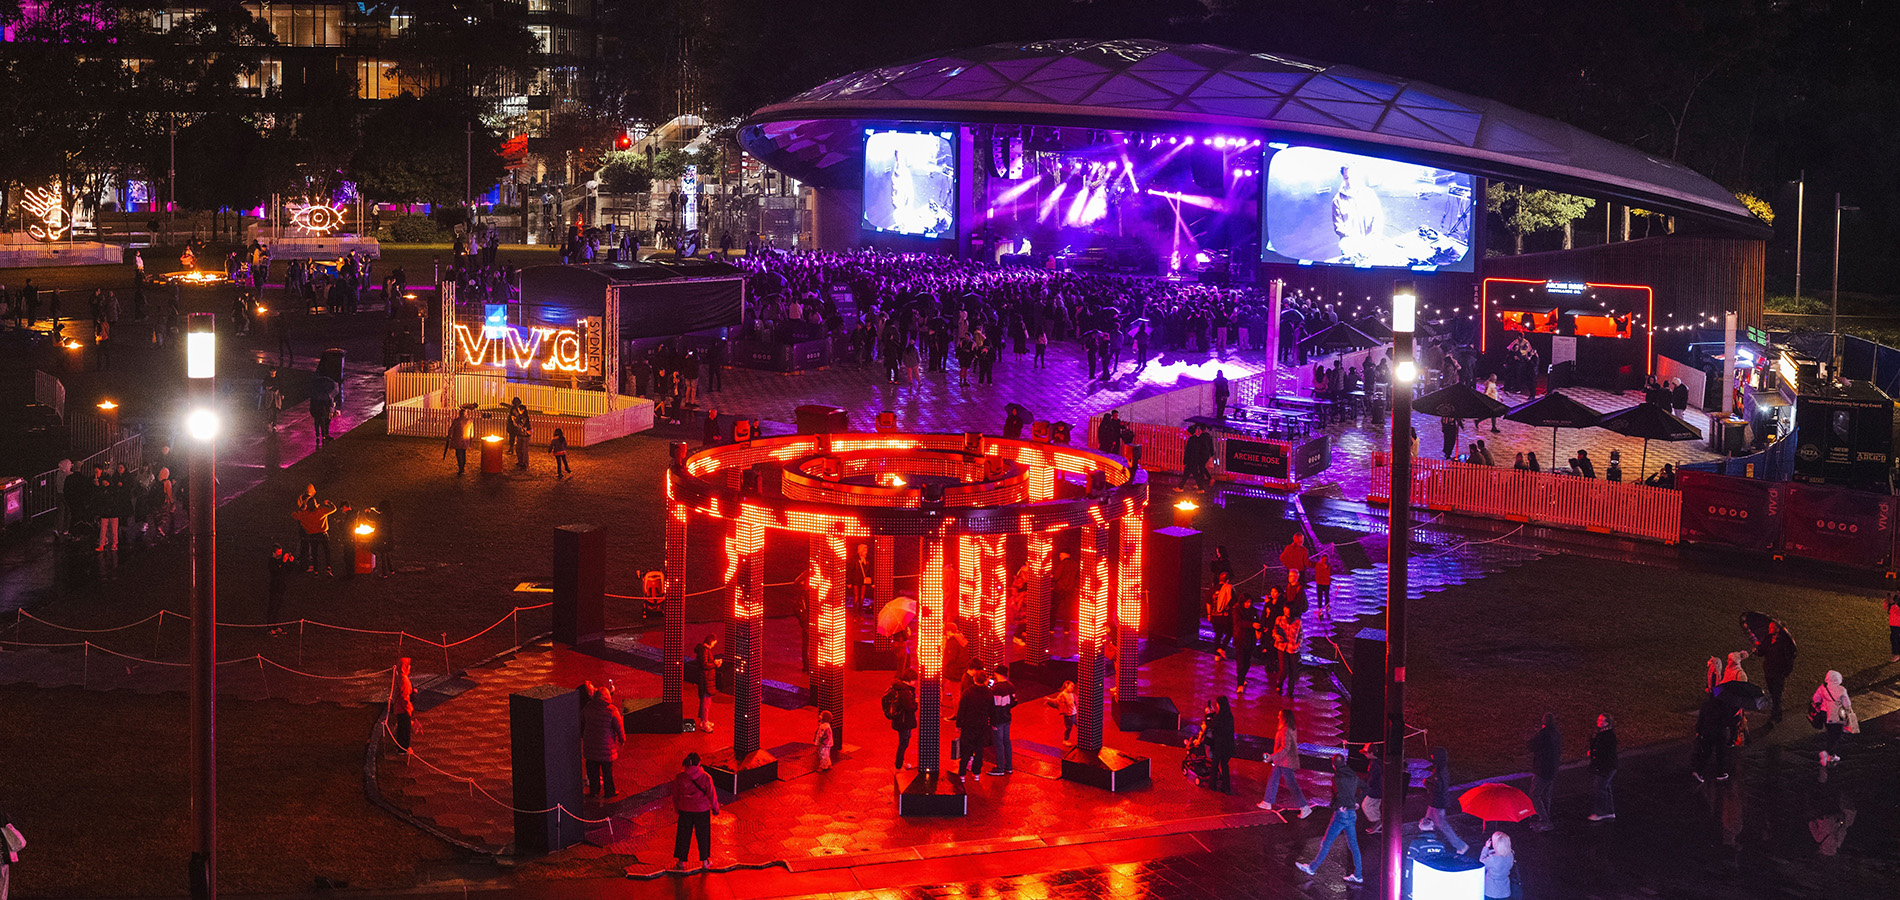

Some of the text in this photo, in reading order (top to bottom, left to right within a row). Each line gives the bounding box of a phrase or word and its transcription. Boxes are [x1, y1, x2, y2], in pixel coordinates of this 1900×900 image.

[590, 321, 600, 372] SYDNEY
[1234, 452, 1260, 462] ARCHIE
[1262, 456, 1280, 464] ROSE
